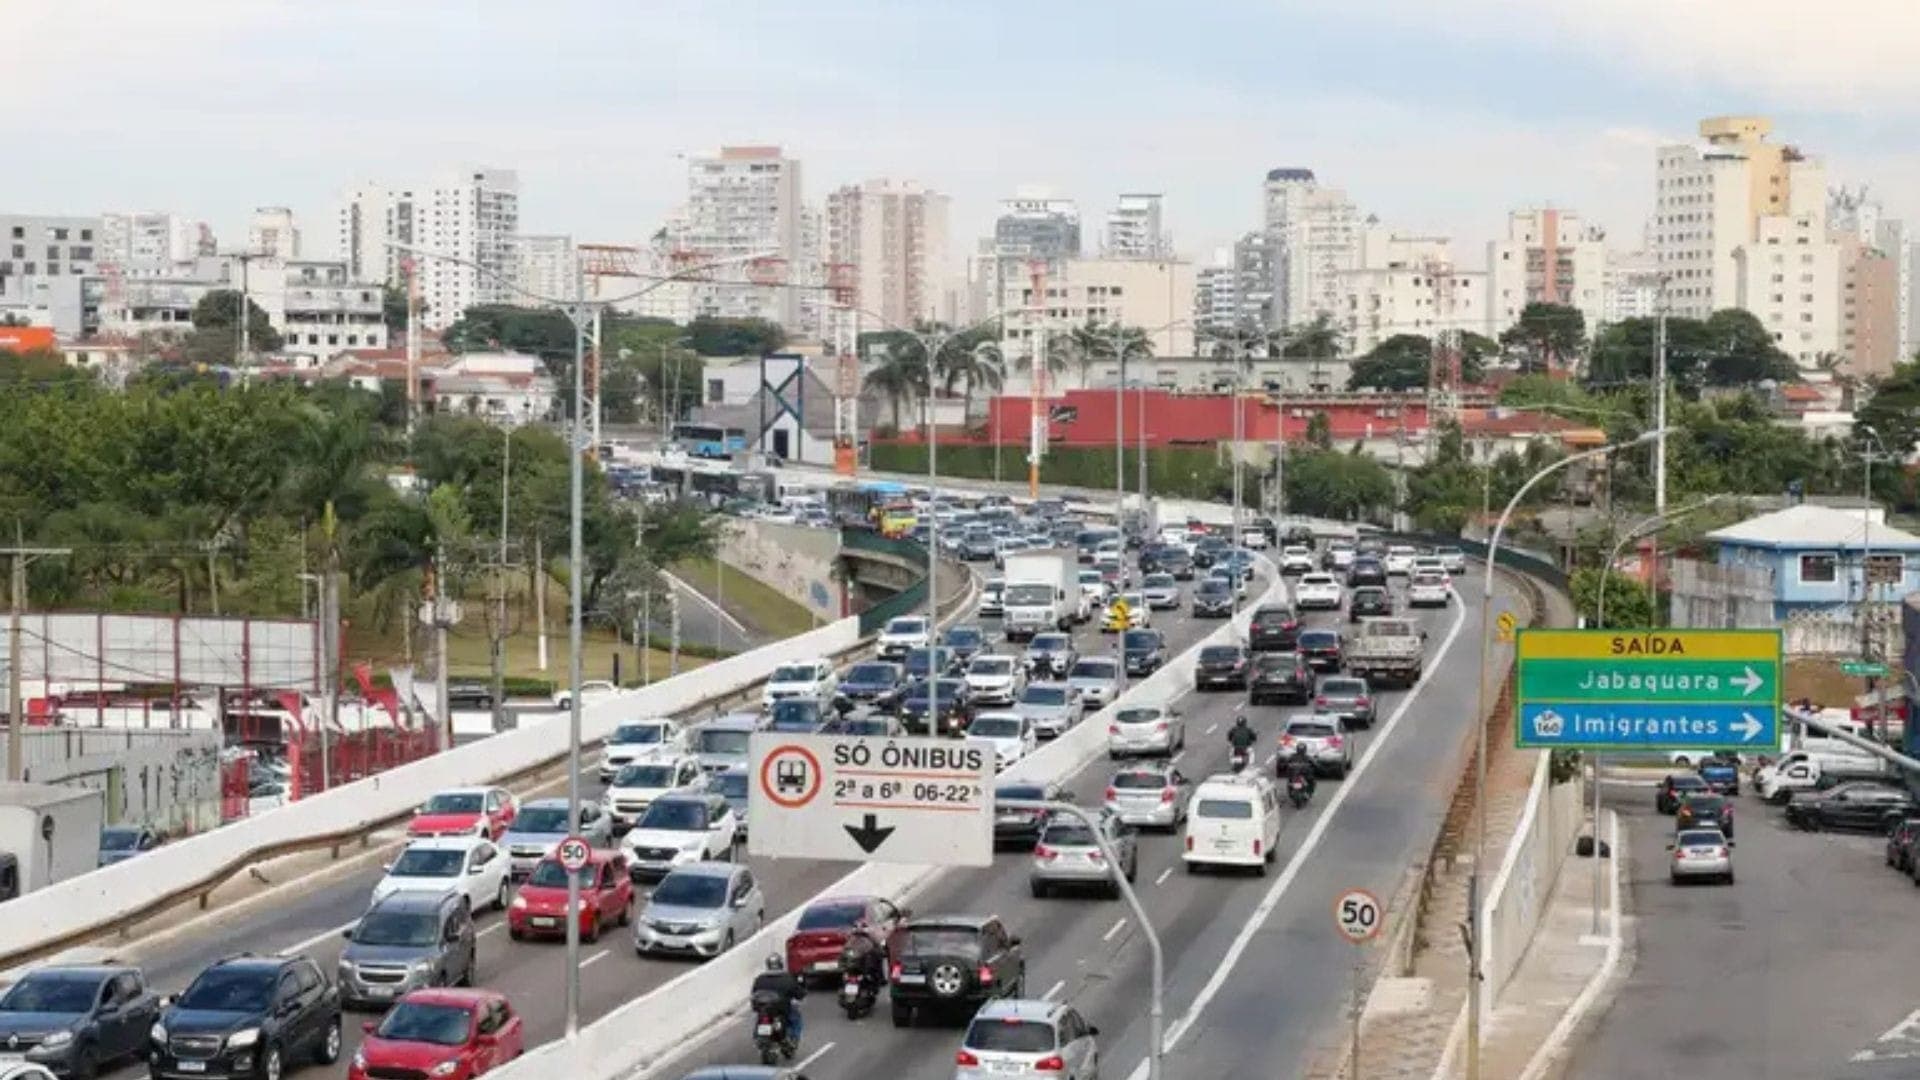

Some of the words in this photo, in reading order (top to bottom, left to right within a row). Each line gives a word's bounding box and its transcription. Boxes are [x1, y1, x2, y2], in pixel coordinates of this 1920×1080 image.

[1611, 633, 1684, 654] SAÍDA
[1578, 671, 1719, 692] Jabaquara
[1575, 714, 1719, 736] Imigrantes
[834, 738, 871, 766] SÓ
[882, 740, 982, 770] ÔNIBUS
[862, 784, 874, 799] a
[563, 845, 585, 859] 50
[1343, 900, 1375, 926] 50
